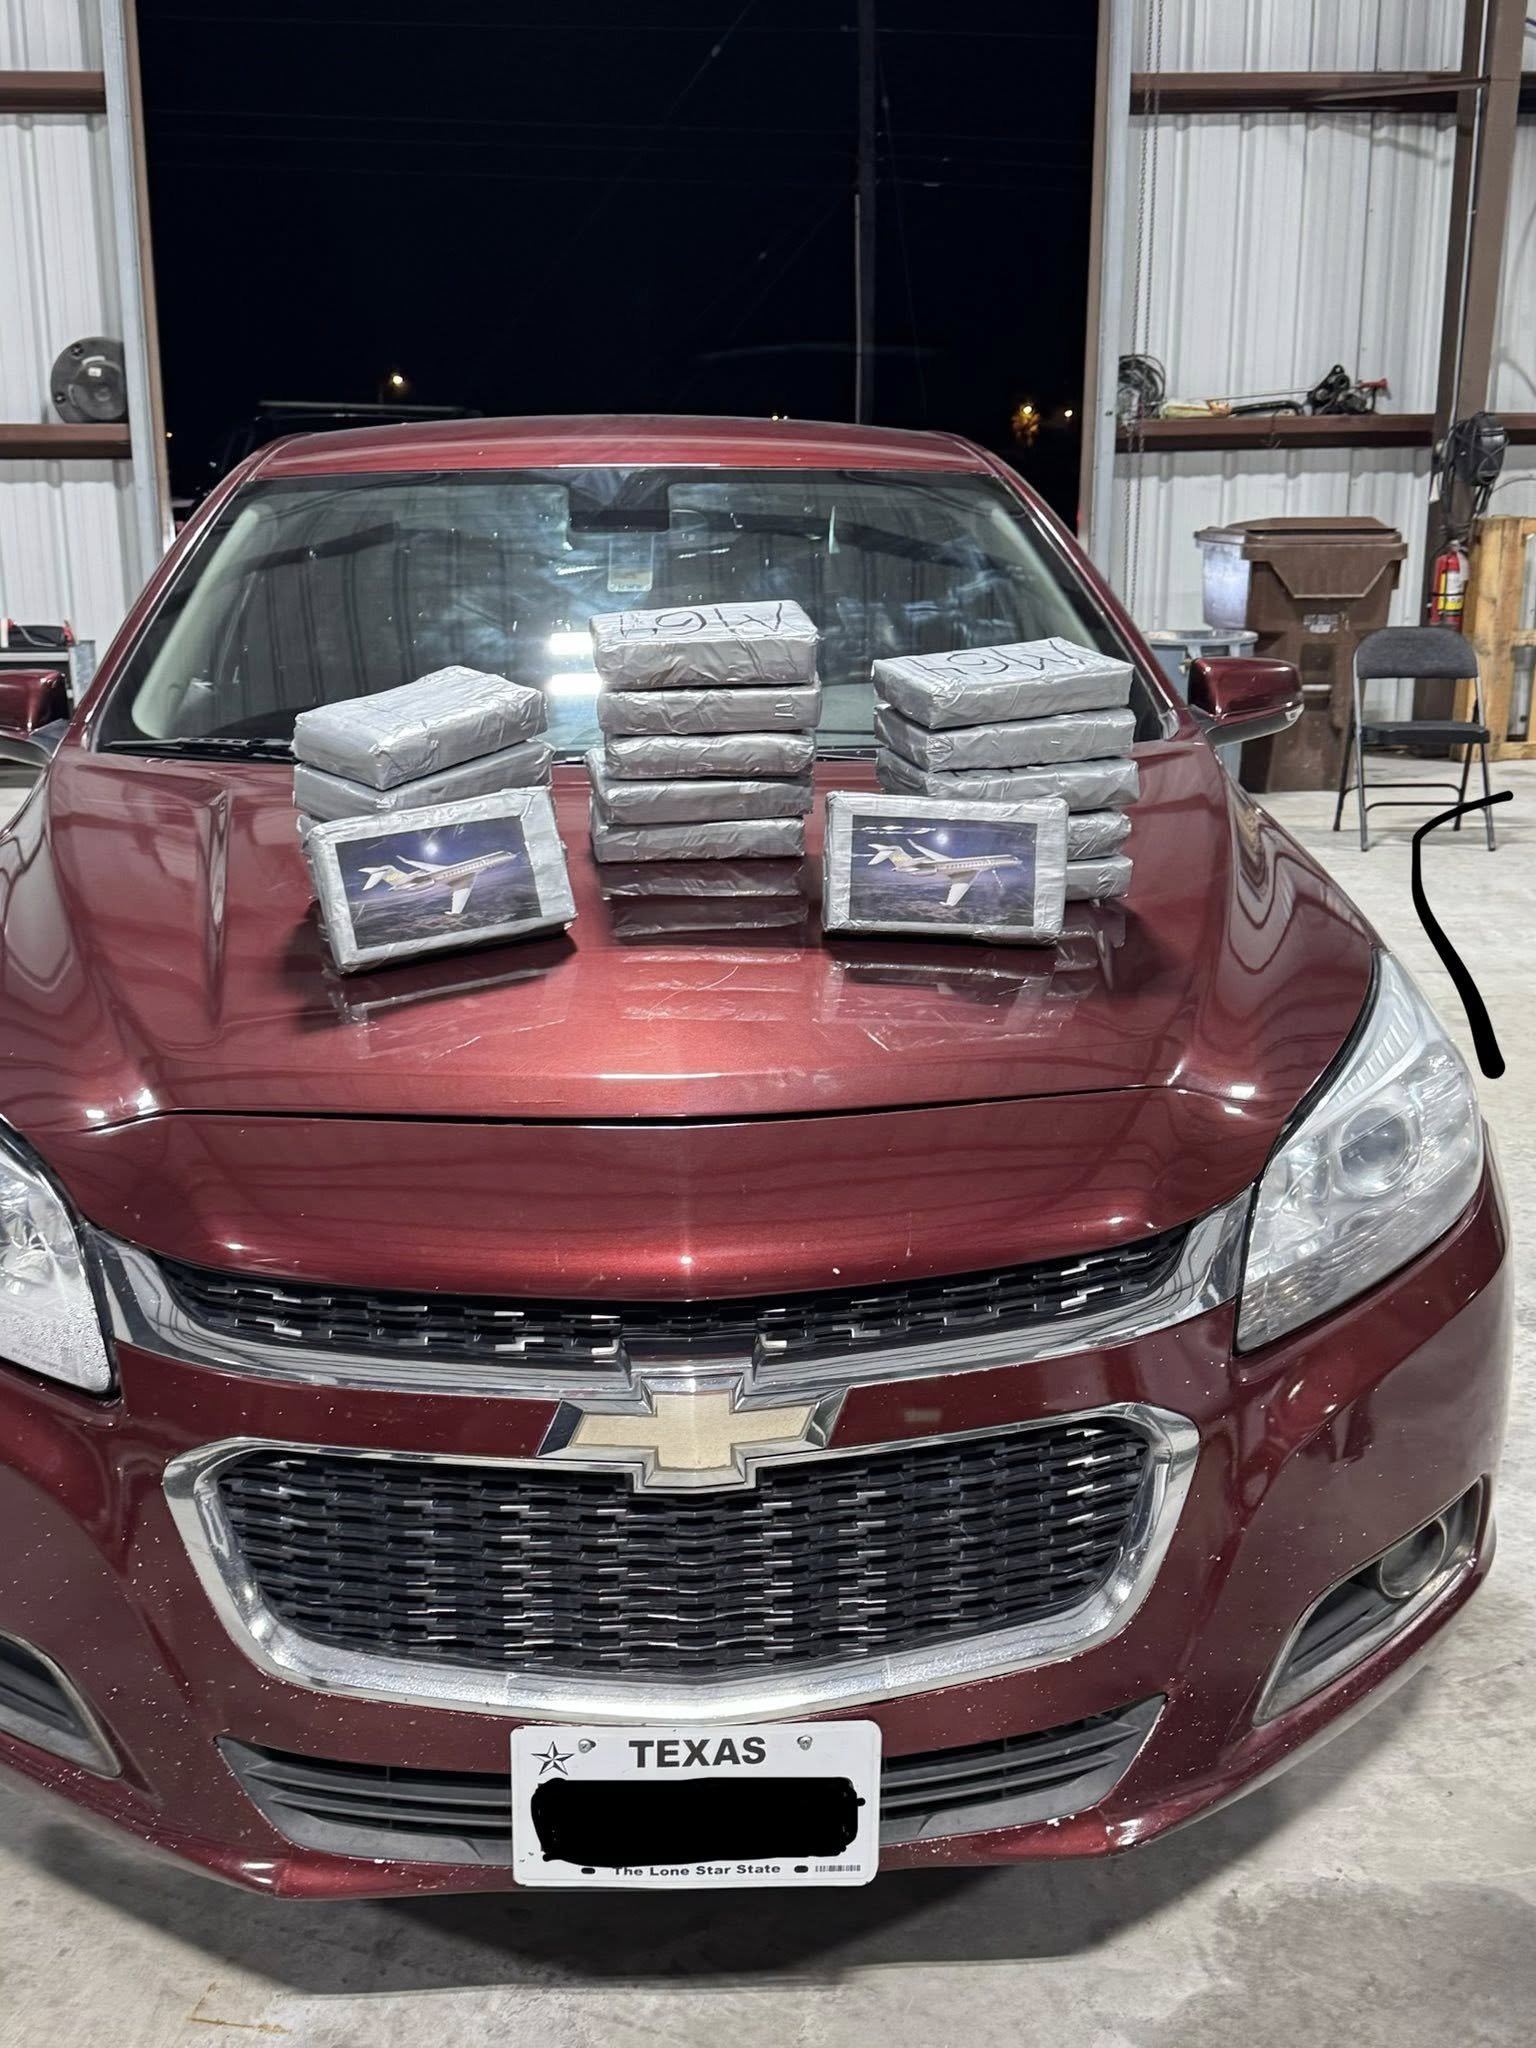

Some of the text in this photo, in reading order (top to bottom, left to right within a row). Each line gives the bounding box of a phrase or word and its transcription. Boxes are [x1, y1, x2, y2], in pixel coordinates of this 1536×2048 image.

[628, 1736, 767, 1769] TEXAS
[613, 1864, 781, 1877] The Lone Star State
